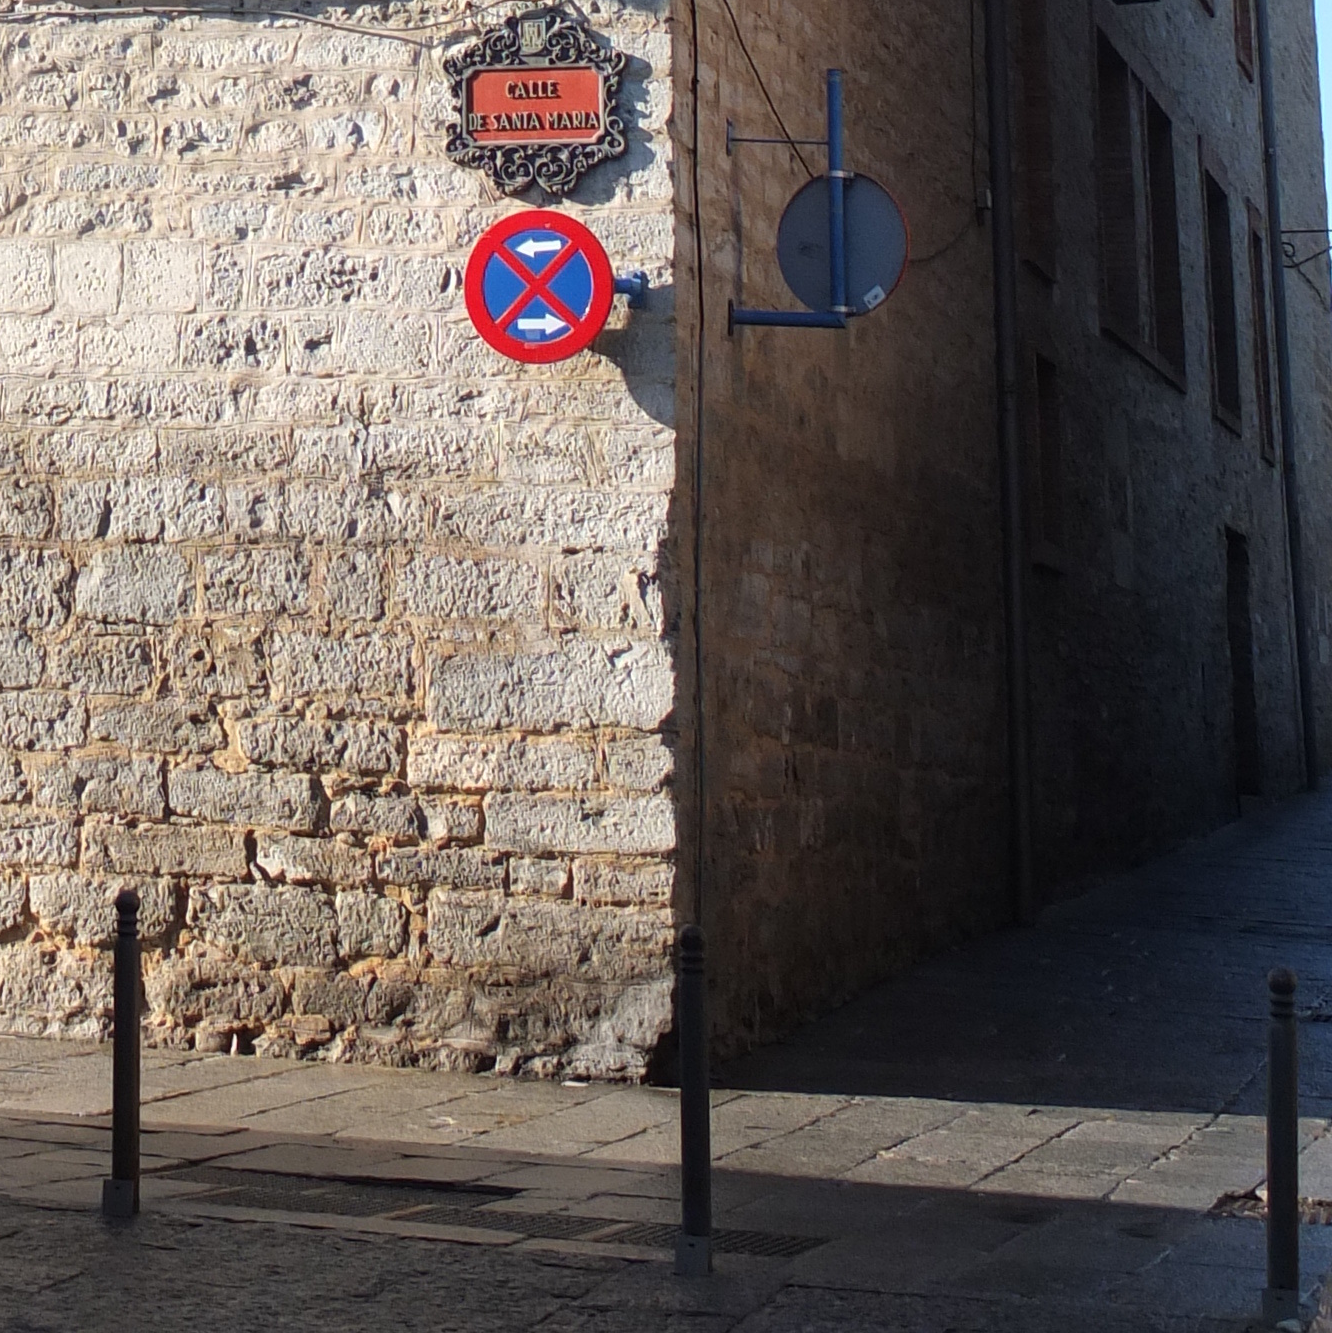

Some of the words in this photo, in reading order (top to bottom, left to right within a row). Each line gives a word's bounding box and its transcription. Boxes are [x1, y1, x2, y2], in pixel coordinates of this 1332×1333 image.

[506, 80, 559, 98] CALLE
[469, 113, 486, 131] DE
[491, 112, 540, 130] SANTA
[546, 110, 599, 129] MARIA
